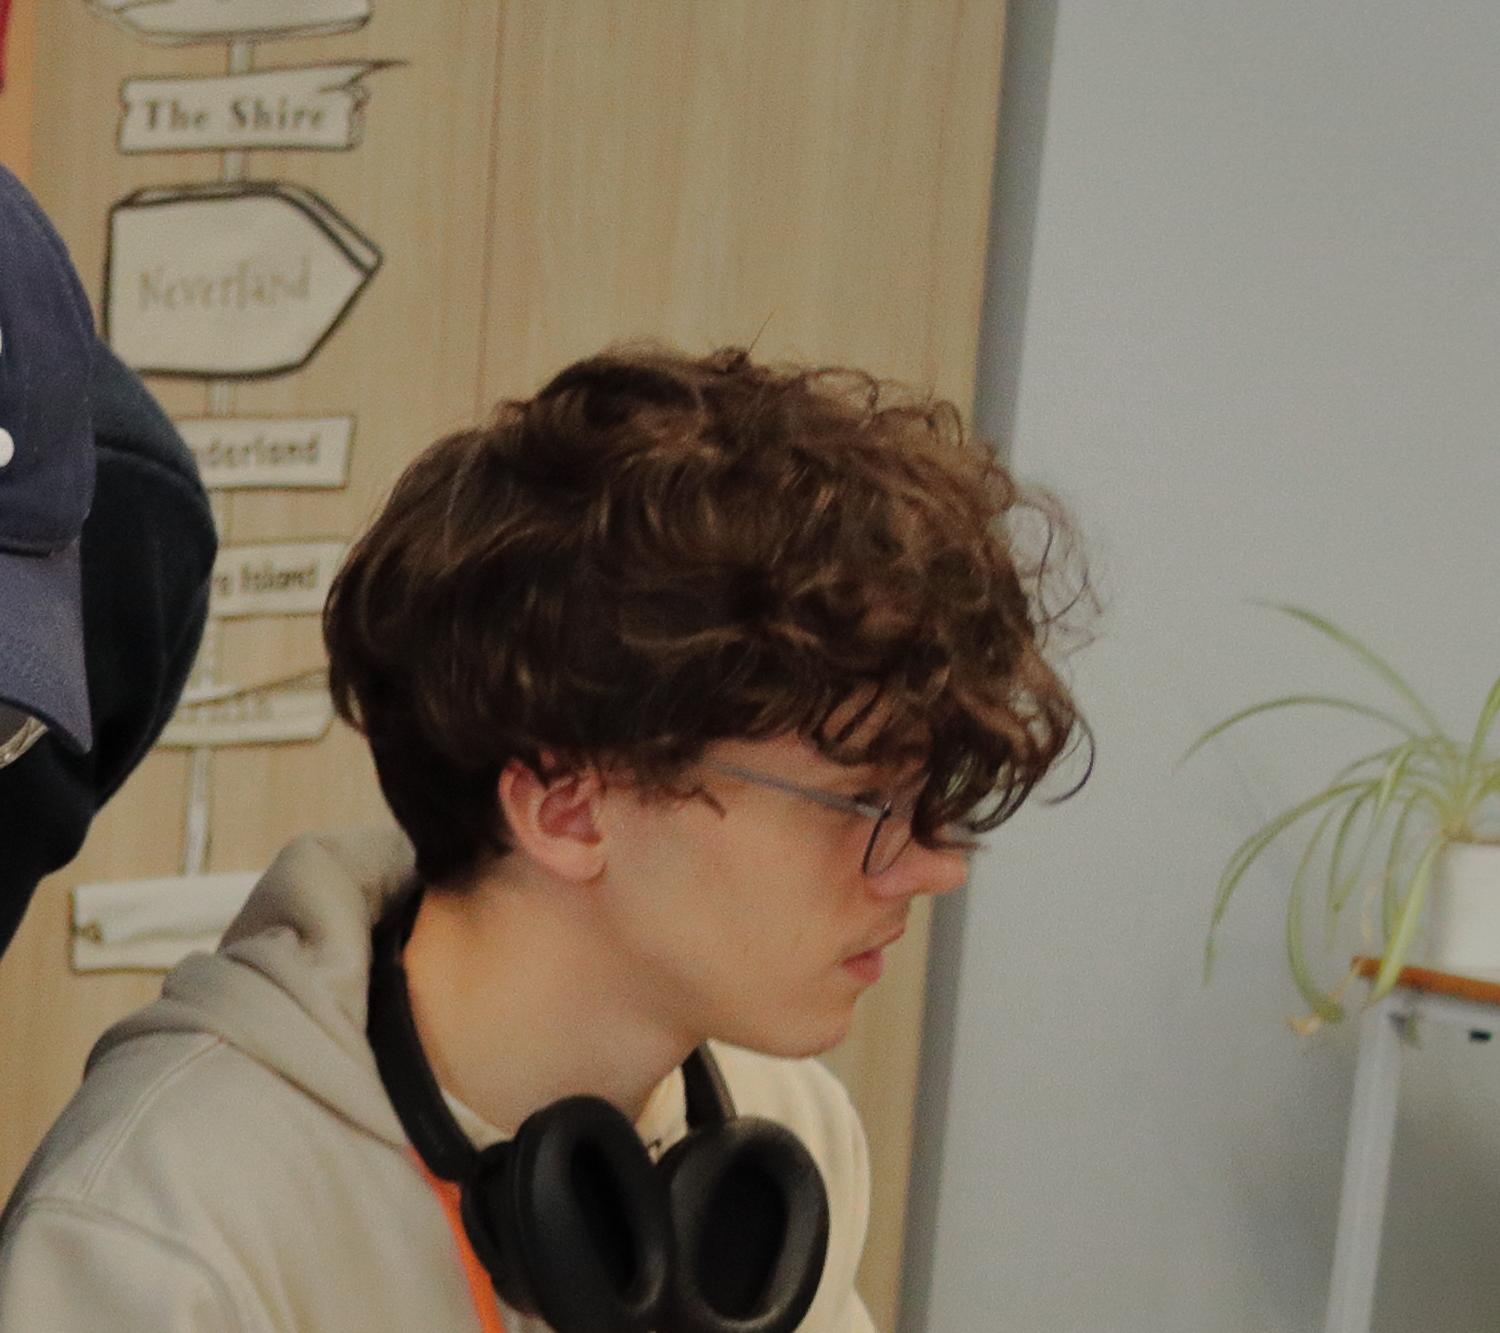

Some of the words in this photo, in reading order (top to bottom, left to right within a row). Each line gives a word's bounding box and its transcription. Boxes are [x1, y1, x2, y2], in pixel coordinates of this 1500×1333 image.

[145, 98, 206, 132] The
[230, 97, 329, 132] Shire
[136, 256, 312, 311] Neverland
